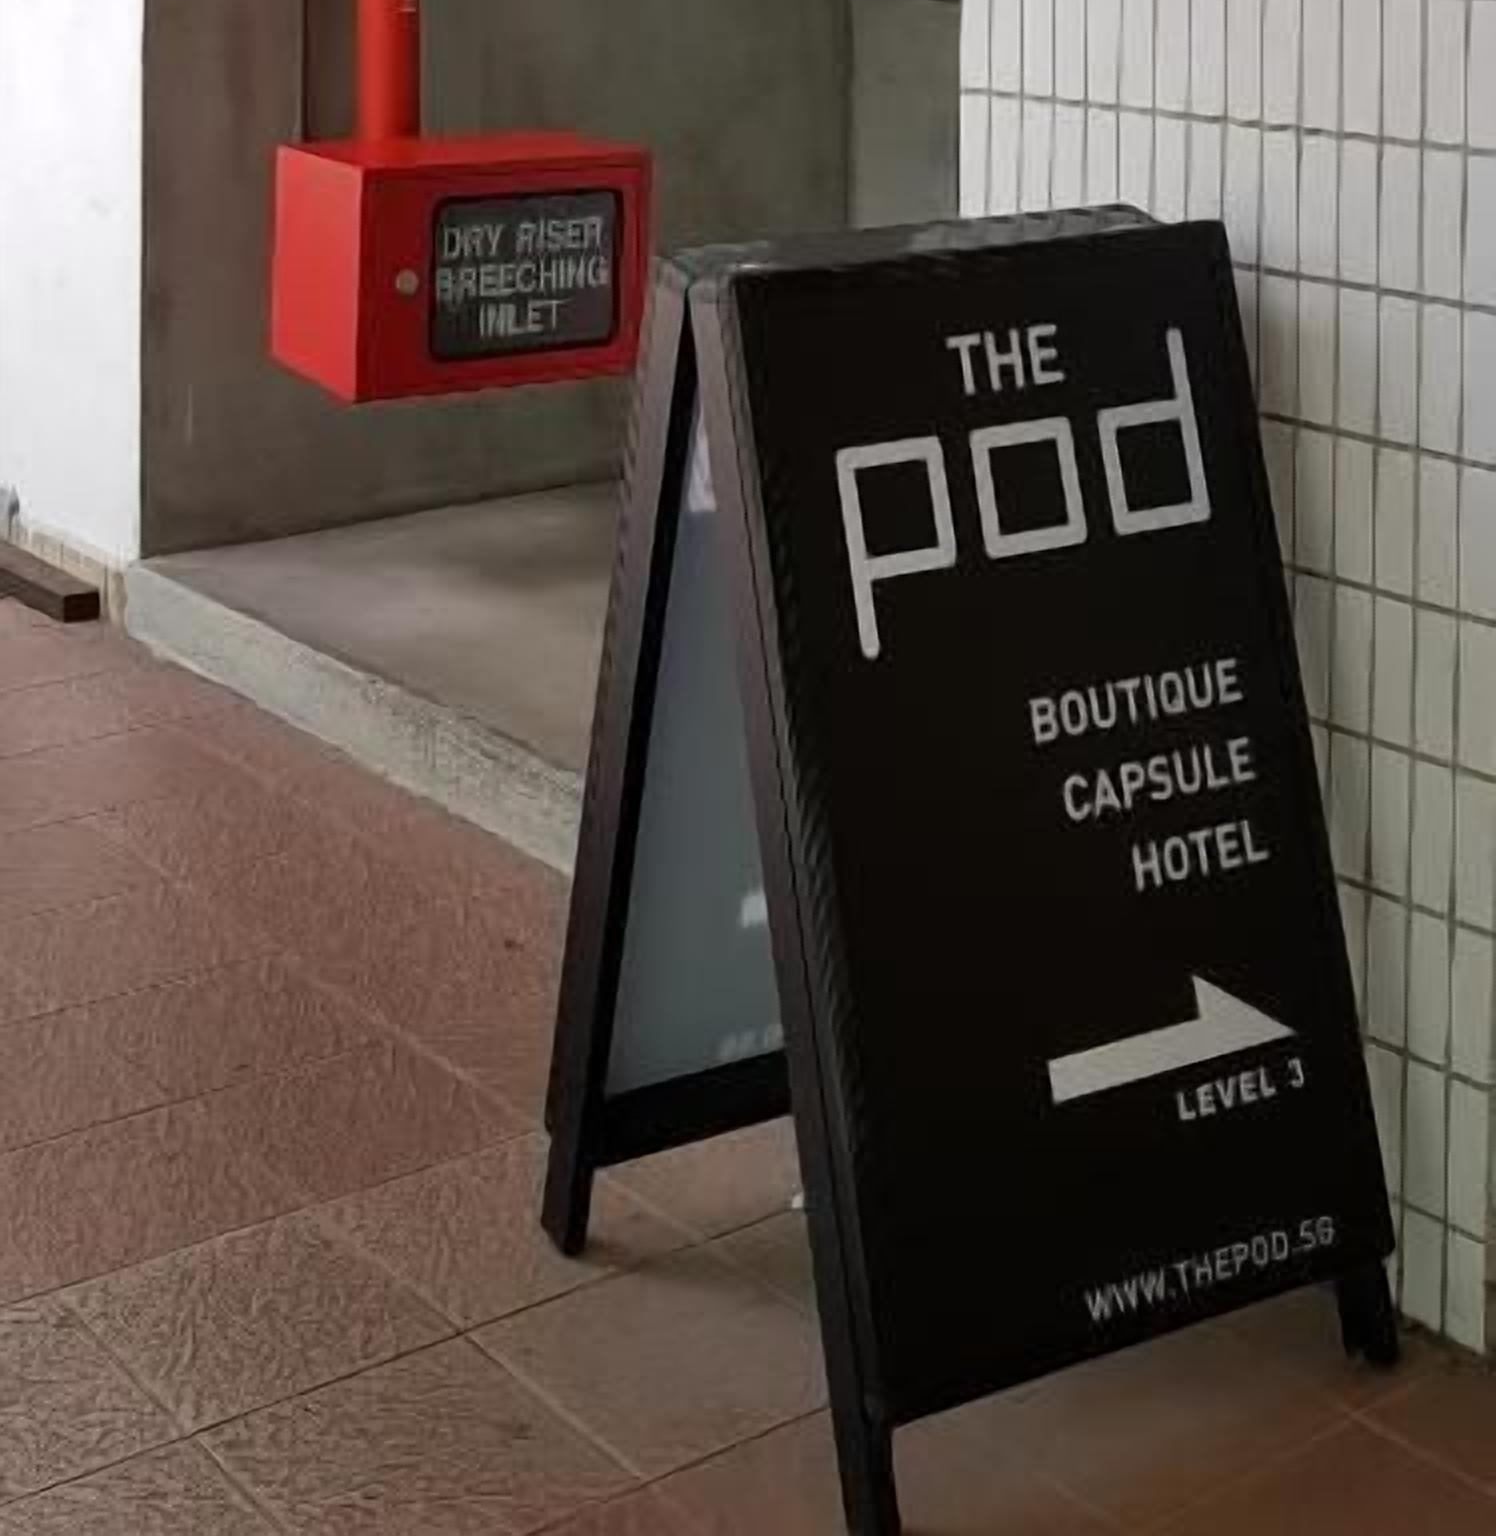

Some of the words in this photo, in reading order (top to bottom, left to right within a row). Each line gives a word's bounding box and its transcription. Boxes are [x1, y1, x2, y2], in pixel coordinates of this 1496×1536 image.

[443, 225, 503, 259] DRY
[516, 216, 603, 254] RISER
[436, 257, 609, 304] BREECHING
[478, 298, 569, 339] INLET
[946, 324, 1066, 396] THE
[836, 328, 1212, 660] pod
[1029, 657, 1243, 745] BOUTIQUE
[1063, 736, 1256, 821] CAPSULE
[1131, 818, 1269, 891] HOTEL
[1176, 1066, 1276, 1121] LEVEL
[1287, 1058, 1305, 1089] 3
[1085, 1216, 1336, 1322] WWW.THEPOD.SG
